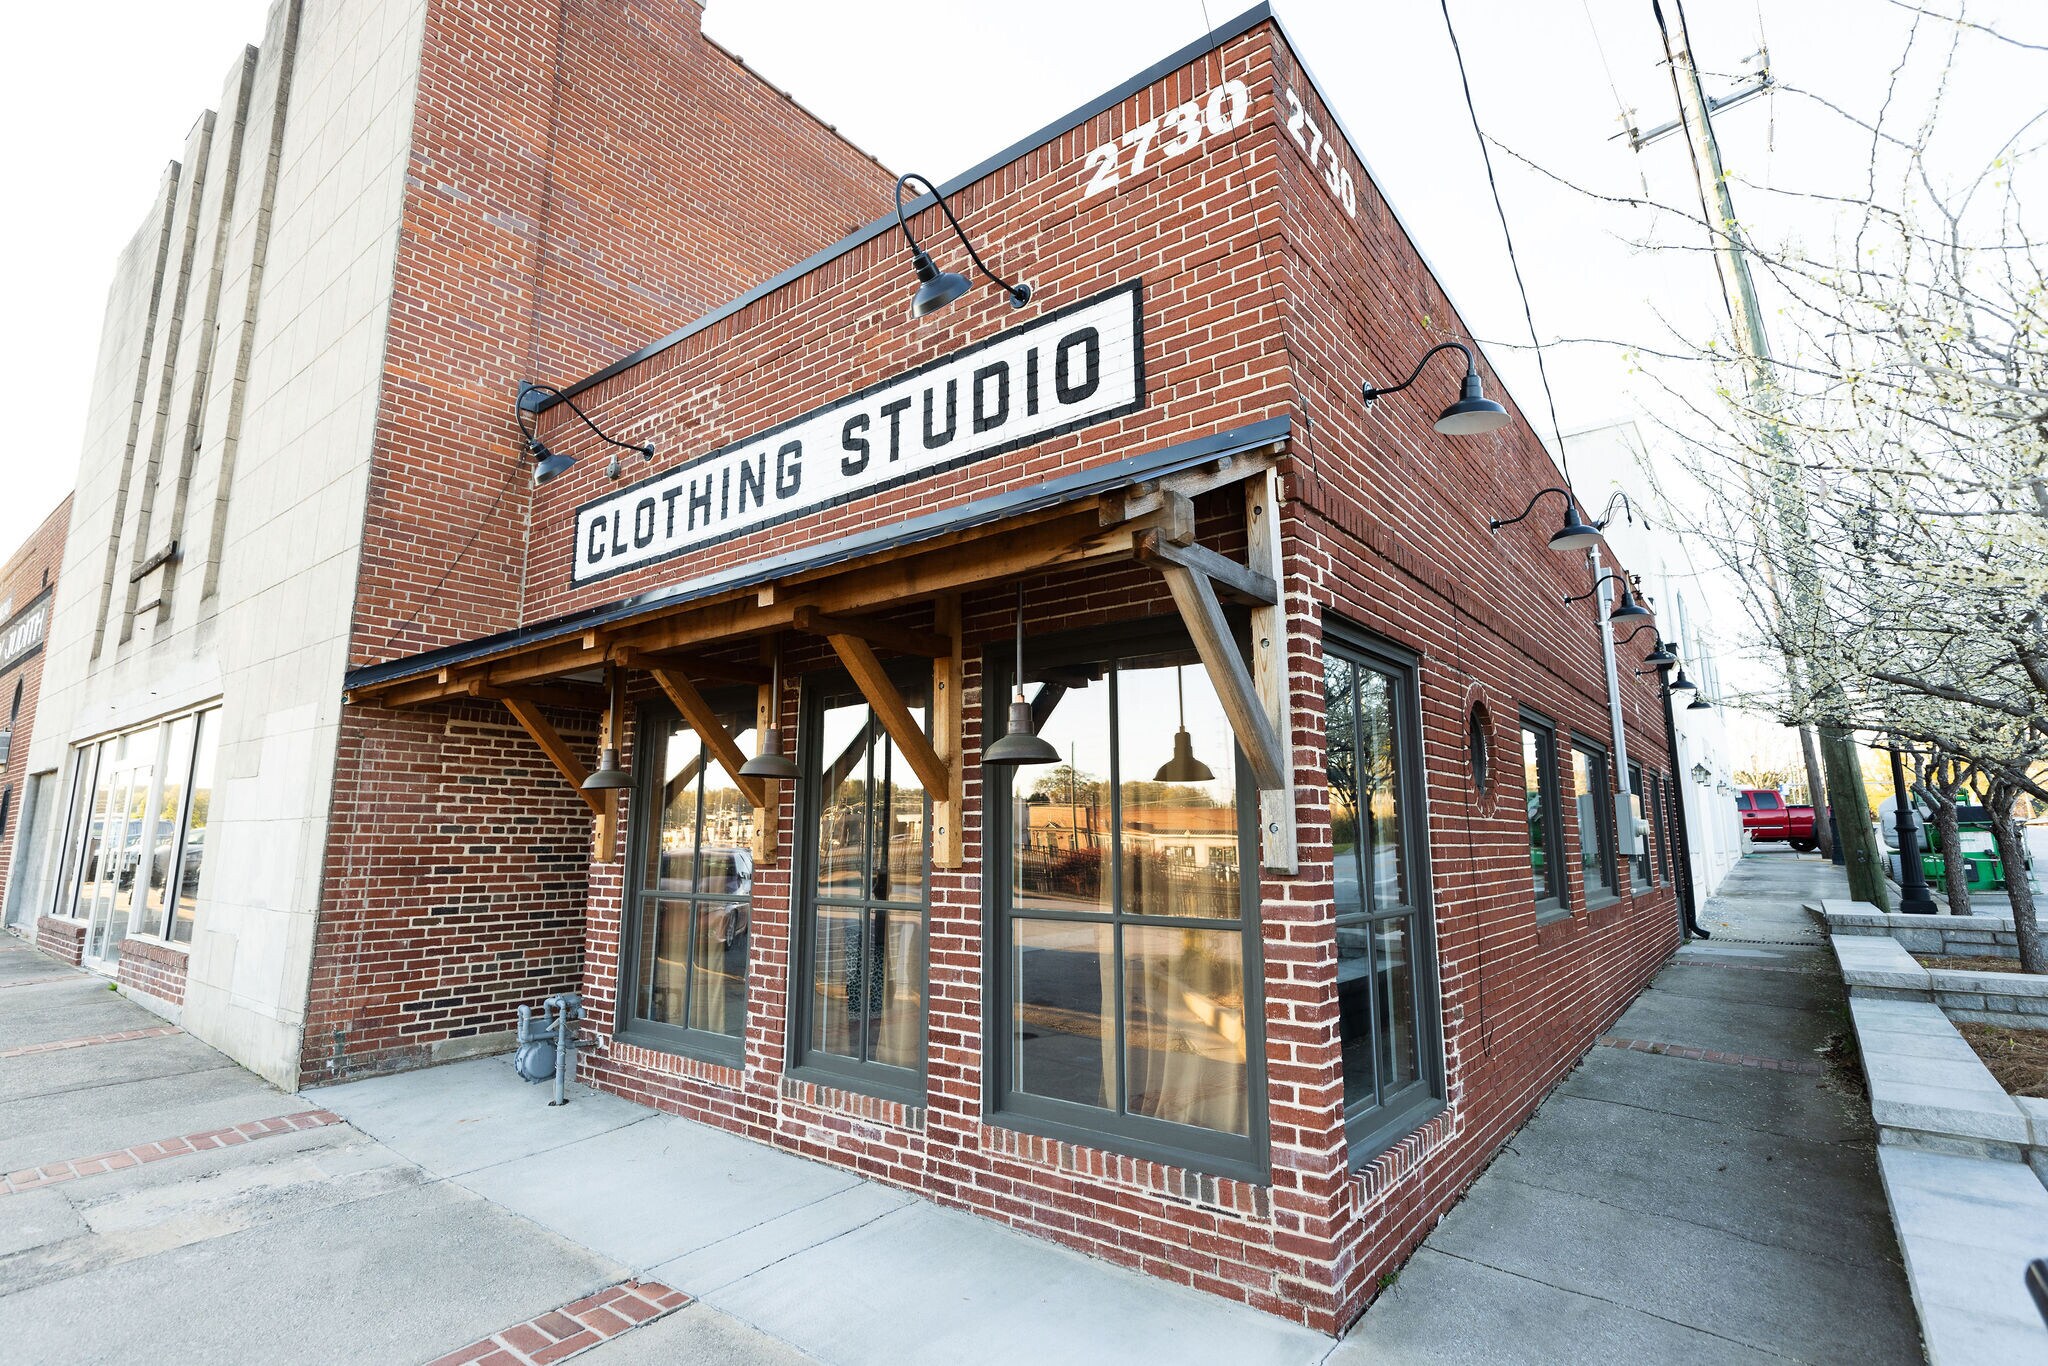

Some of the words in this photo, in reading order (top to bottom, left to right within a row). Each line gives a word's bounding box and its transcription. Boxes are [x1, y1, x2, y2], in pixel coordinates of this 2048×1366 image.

[1084, 79, 1249, 198] 2730
[1286, 88, 1355, 219] 2730
[587, 439, 802, 564] CLOTHING
[841, 326, 1099, 477] STUDIO
[5, 608, 45, 659] JUDITH
